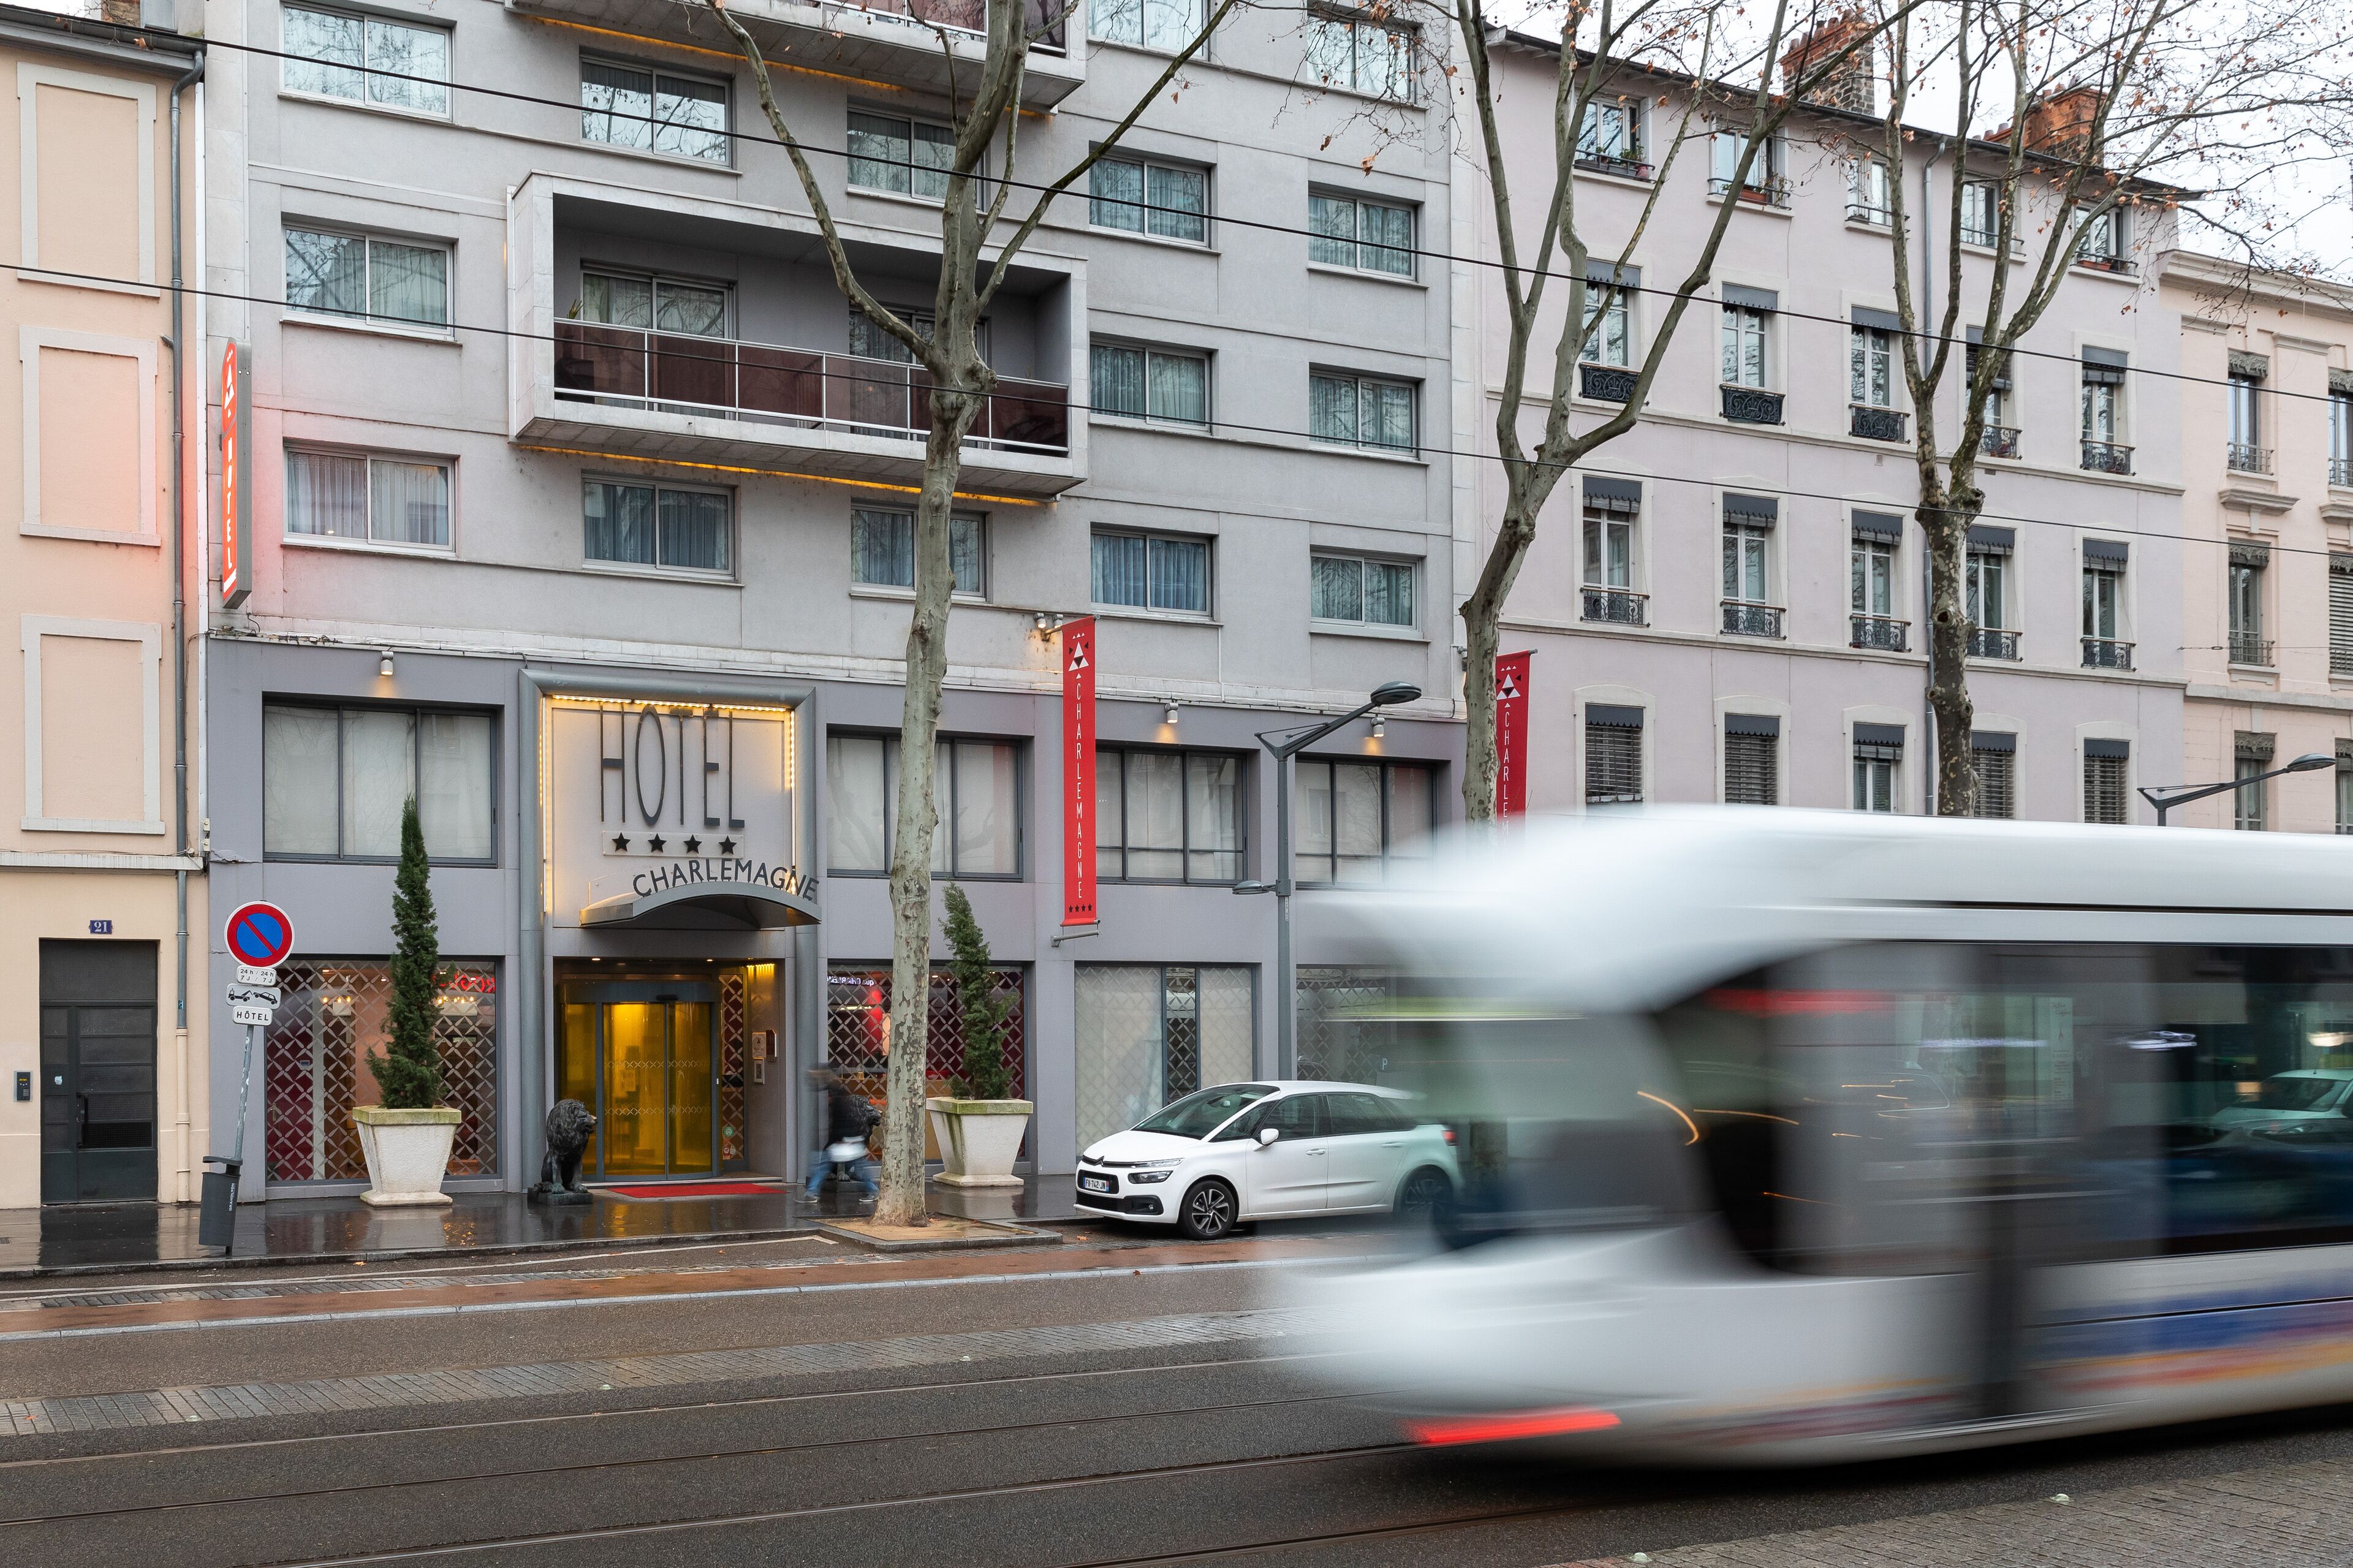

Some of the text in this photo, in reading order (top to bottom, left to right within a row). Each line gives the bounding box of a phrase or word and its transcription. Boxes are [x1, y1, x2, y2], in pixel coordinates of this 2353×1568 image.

[600, 702, 745, 828] HOTEL
[633, 858, 819, 901] CHARLEMAGNE
[94, 921, 108, 932] 21
[237, 1010, 268, 1021] HÔTEL
